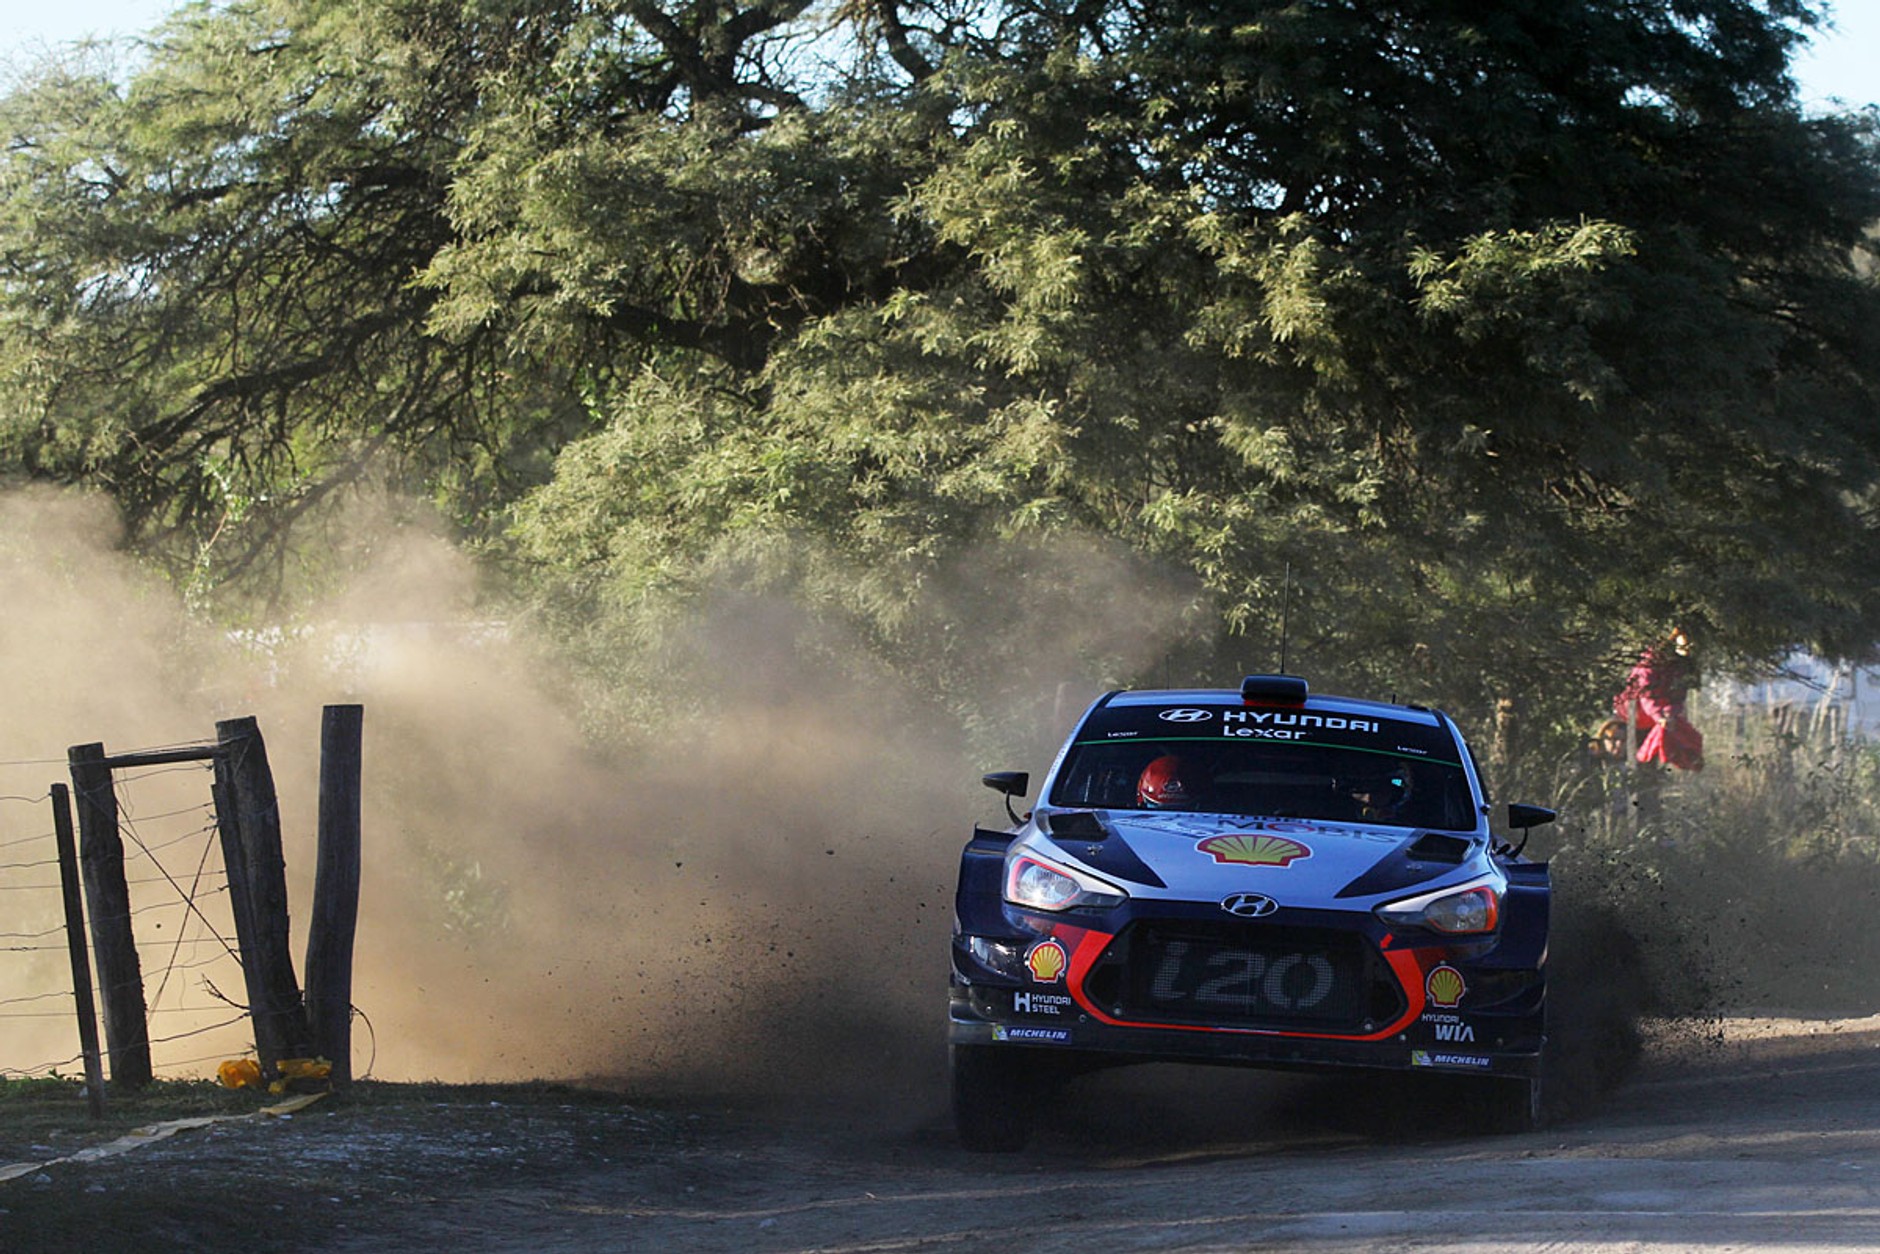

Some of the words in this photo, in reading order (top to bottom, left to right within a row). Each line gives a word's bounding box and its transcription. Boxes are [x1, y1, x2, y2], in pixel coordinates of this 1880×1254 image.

[1223, 711, 1379, 732] HYUNDAI
[1223, 725, 1307, 739] Lexar
[1032, 993, 1072, 1006] HYUNDAI
[1032, 1004, 1061, 1015] STEEL
[1422, 1013, 1460, 1023] HYUNDAI
[1010, 1029, 1067, 1040] MICHELIN
[1434, 1055, 1490, 1066] MICHELIN
